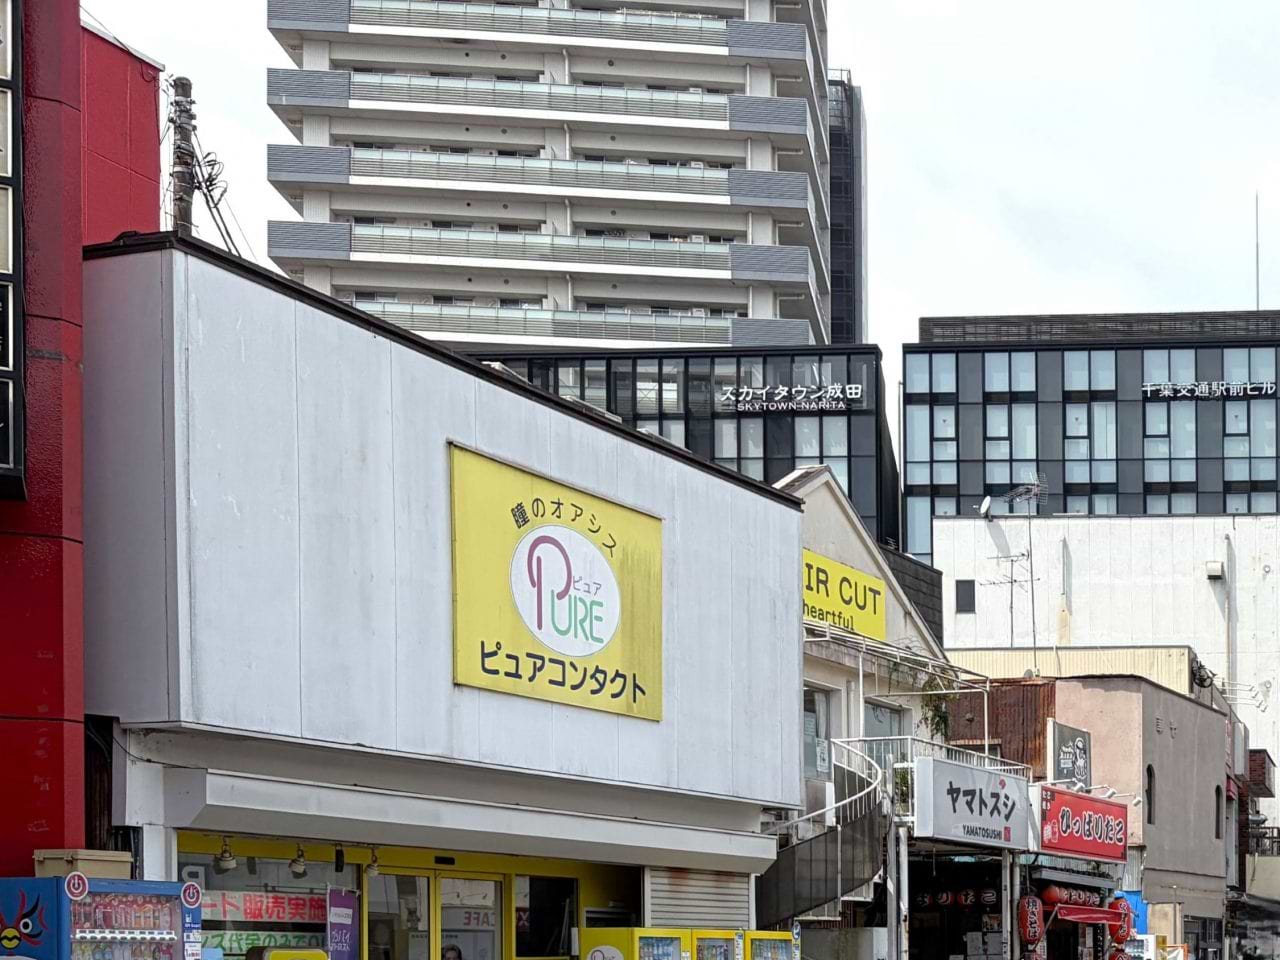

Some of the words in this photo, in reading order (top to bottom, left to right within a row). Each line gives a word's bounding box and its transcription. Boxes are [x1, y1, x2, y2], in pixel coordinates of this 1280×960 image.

[720, 383, 863, 402] スカイタウン成田
[737, 401, 797, 412] SKYTOWN
[801, 401, 846, 411] NARITA
[1141, 381, 1277, 398] 千葉交通駅前ビル
[511, 497, 618, 558] 瞳のオアシス
[527, 535, 605, 644] PURE
[572, 575, 603, 597] ピュア
[839, 576, 881, 616] CUT
[802, 598, 855, 632] heartful
[480, 640, 647, 704] ピュアコンタクト
[946, 781, 1016, 823] ヤマトスシ
[962, 823, 1002, 840] YAMATOSUSHI
